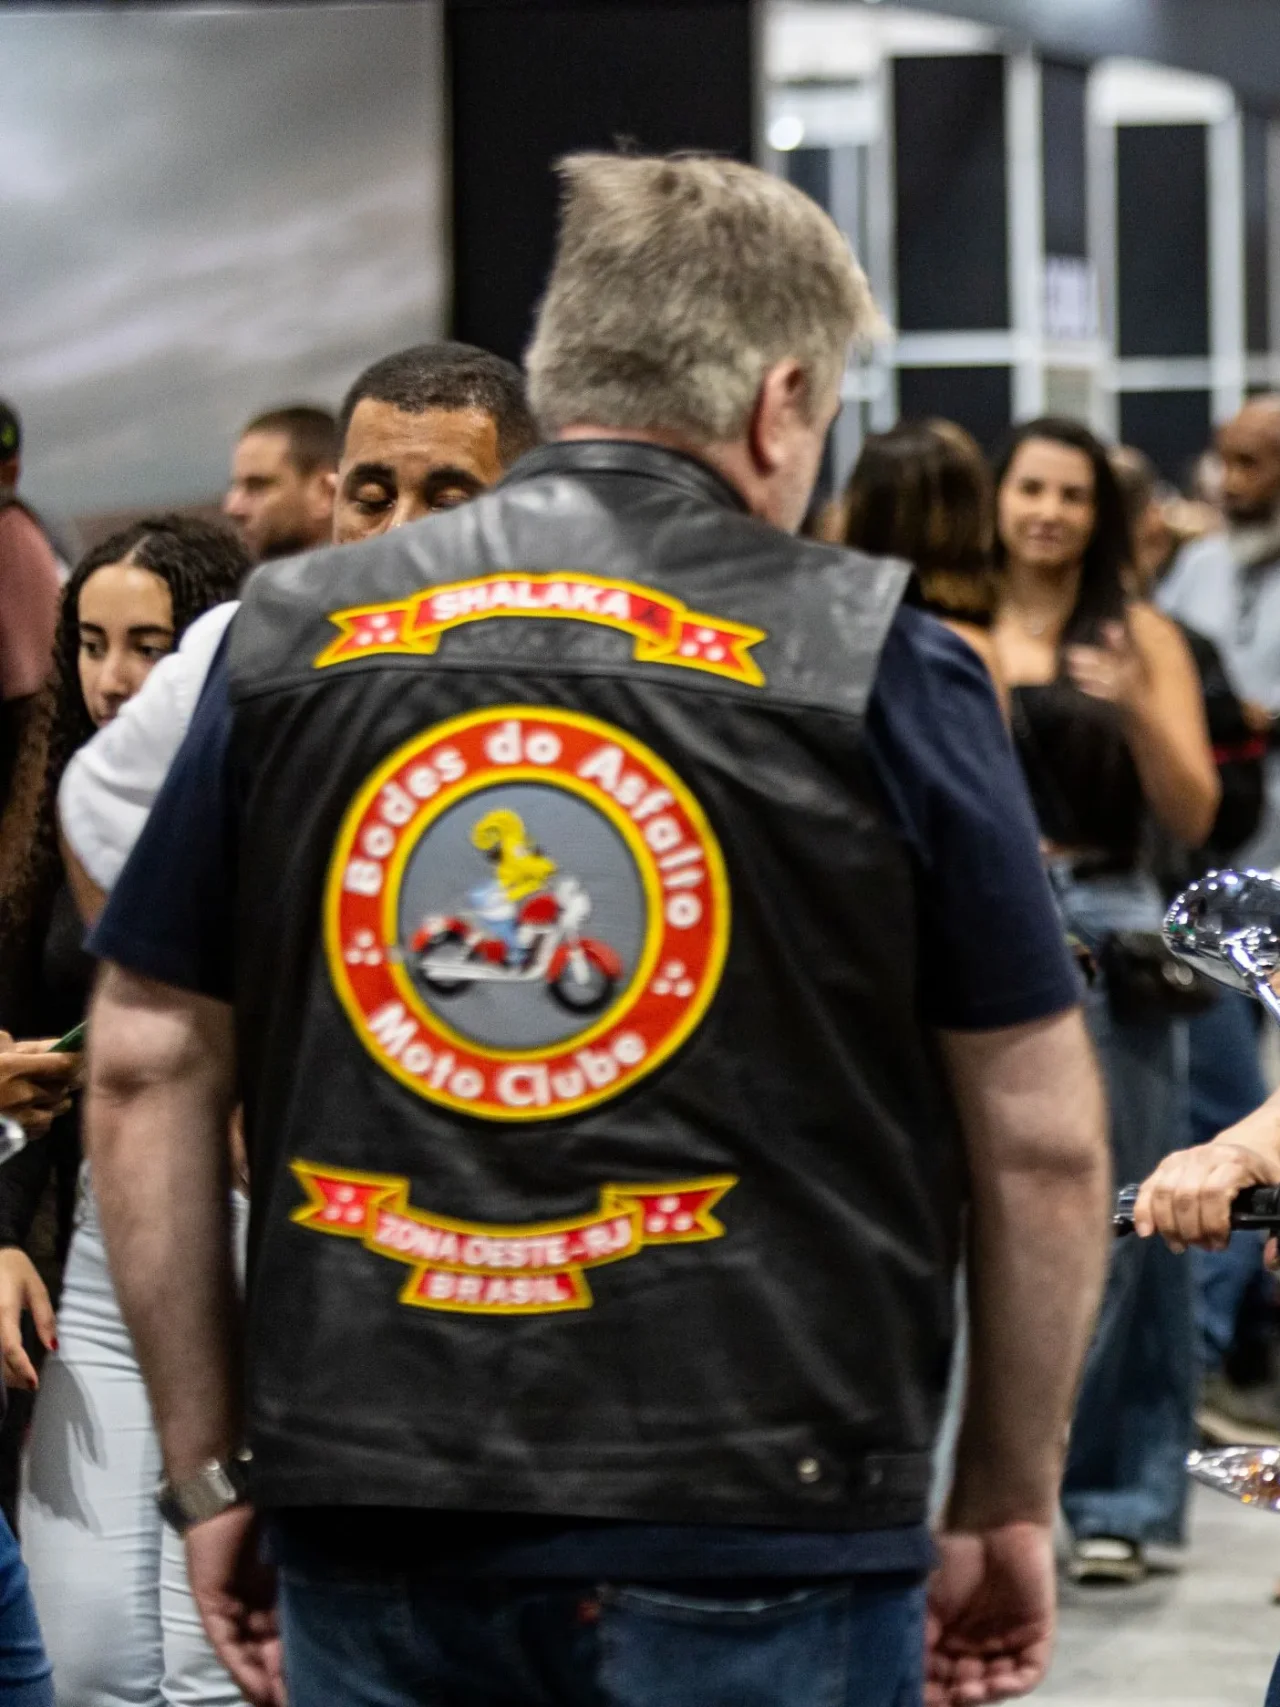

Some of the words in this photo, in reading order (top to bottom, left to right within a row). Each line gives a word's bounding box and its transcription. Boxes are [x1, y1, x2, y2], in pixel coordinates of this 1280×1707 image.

[430, 582, 632, 621] SHALAKA
[344, 746, 467, 896] Bodes
[484, 719, 562, 765] do
[577, 744, 704, 928] Asfalto
[367, 1003, 485, 1099] Moto
[496, 1032, 647, 1107] Clube
[374, 1213, 459, 1263] ZONA
[427, 1273, 569, 1304] BRASIL
